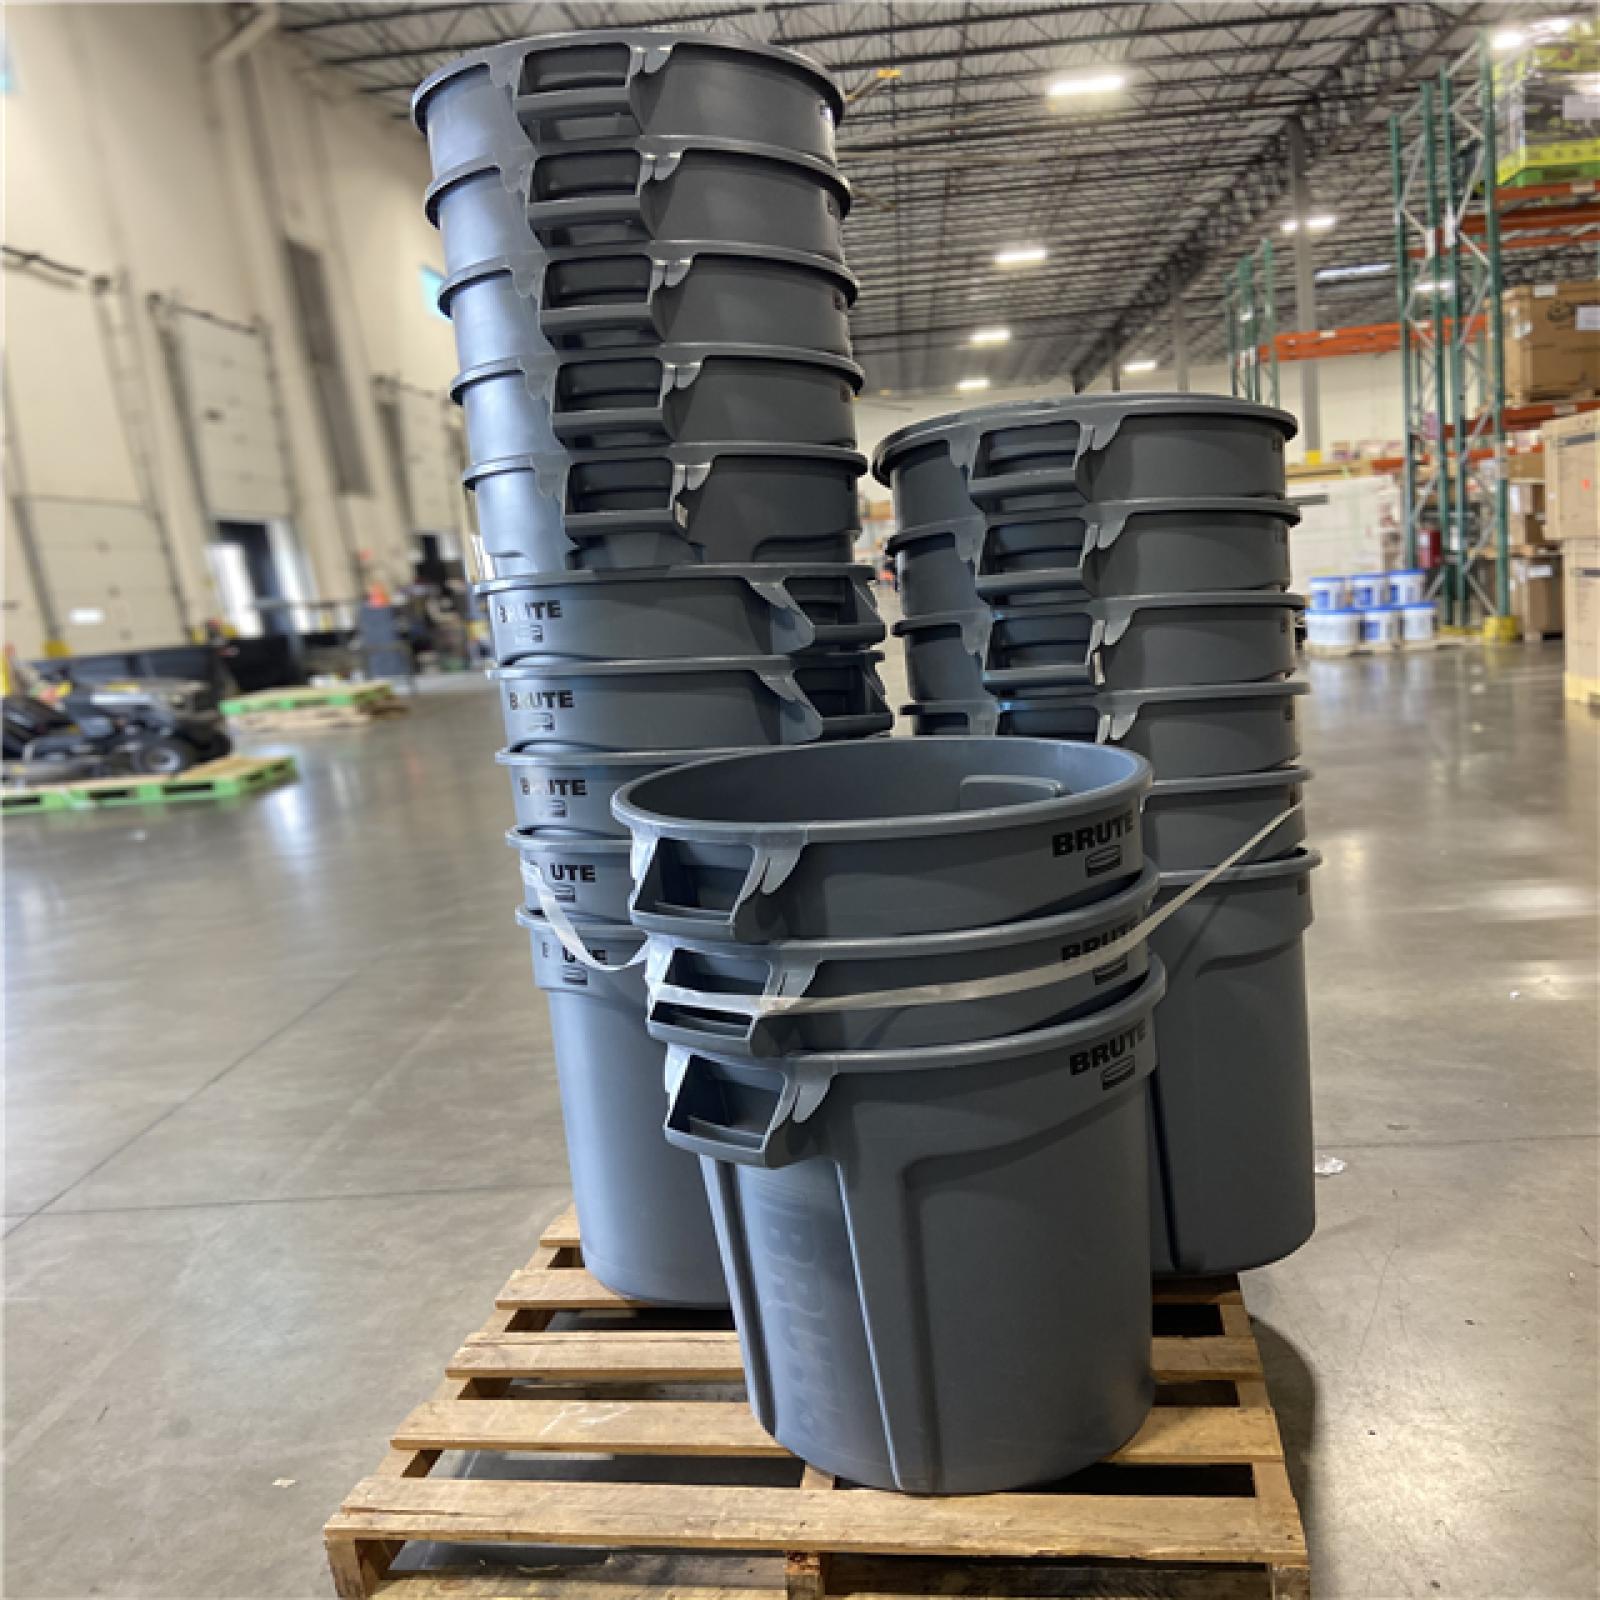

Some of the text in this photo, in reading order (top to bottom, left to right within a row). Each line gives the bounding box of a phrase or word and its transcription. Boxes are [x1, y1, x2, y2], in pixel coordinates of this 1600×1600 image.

[509, 689, 574, 710] BUTE
[1052, 809, 1134, 857] BRUTE
[543, 863, 596, 883] UTE
[1061, 919, 1140, 960] BRU
[1069, 1018, 1146, 1076] BRUTE
